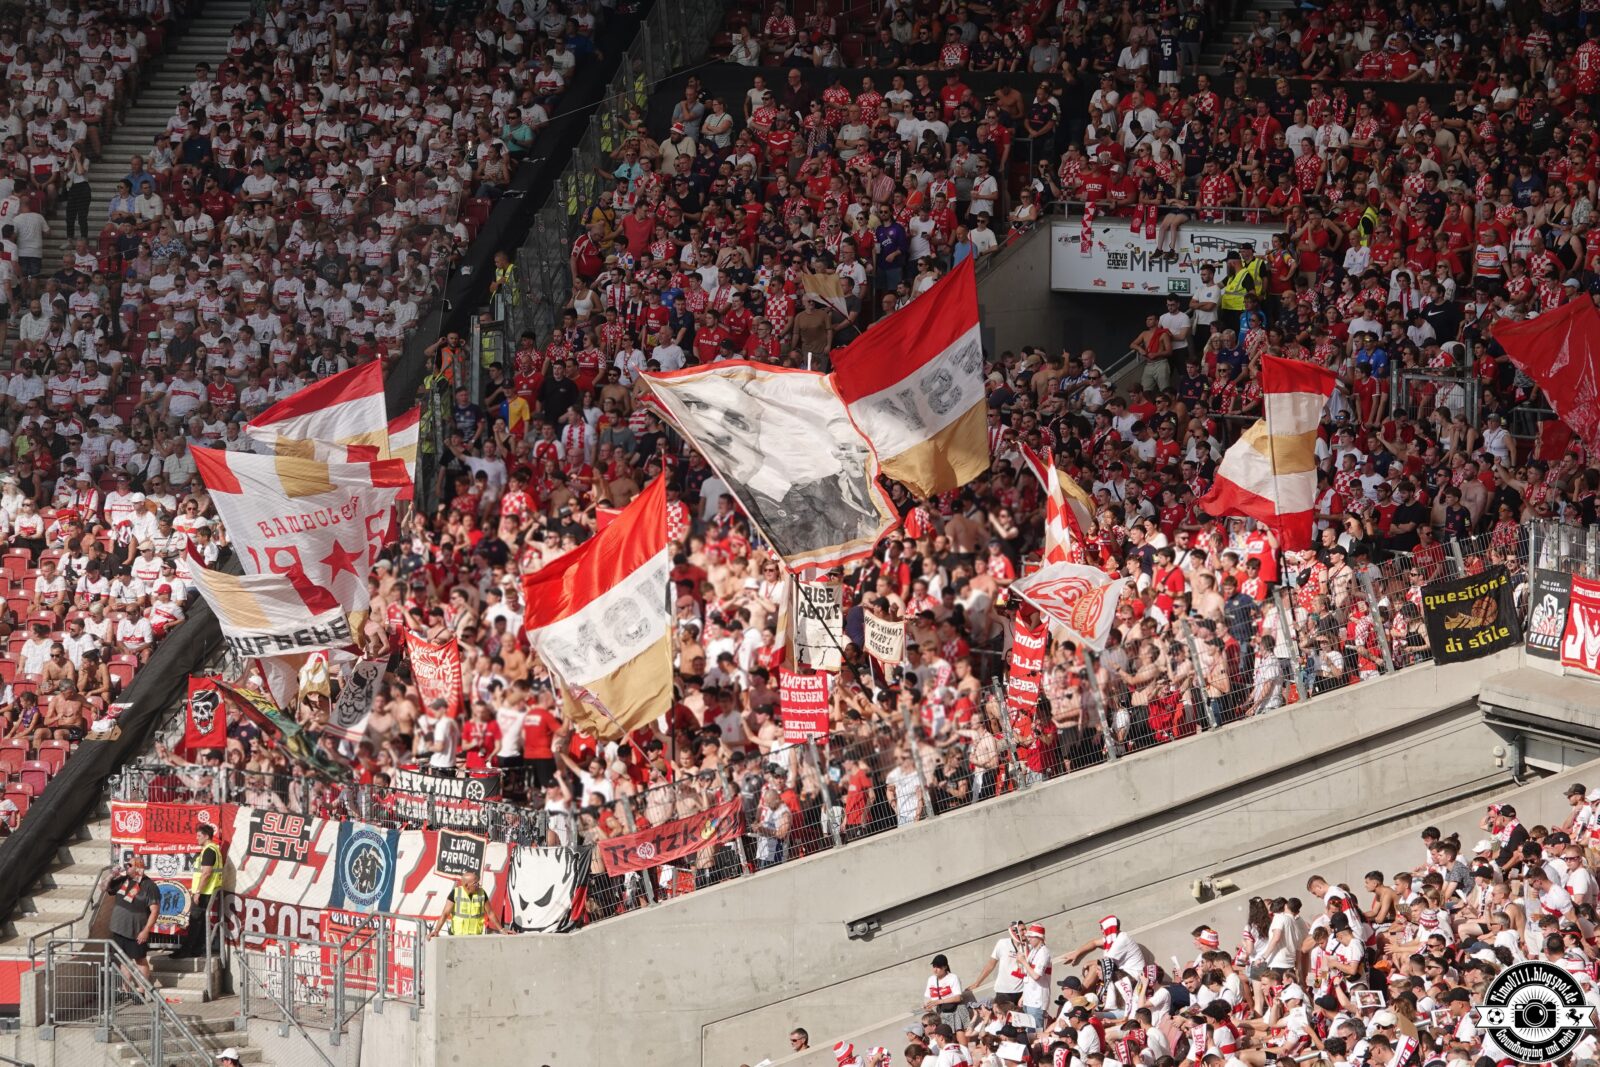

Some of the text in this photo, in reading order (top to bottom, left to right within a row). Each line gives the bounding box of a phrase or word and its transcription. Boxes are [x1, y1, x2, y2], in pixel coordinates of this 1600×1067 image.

[1107, 259, 1128, 267] CREW
[1425, 575, 1508, 610] questione
[1445, 625, 1511, 653] di stile
[790, 691, 824, 703] SIEGEN
[262, 811, 305, 837] SUB
[251, 833, 309, 861] CIETY
